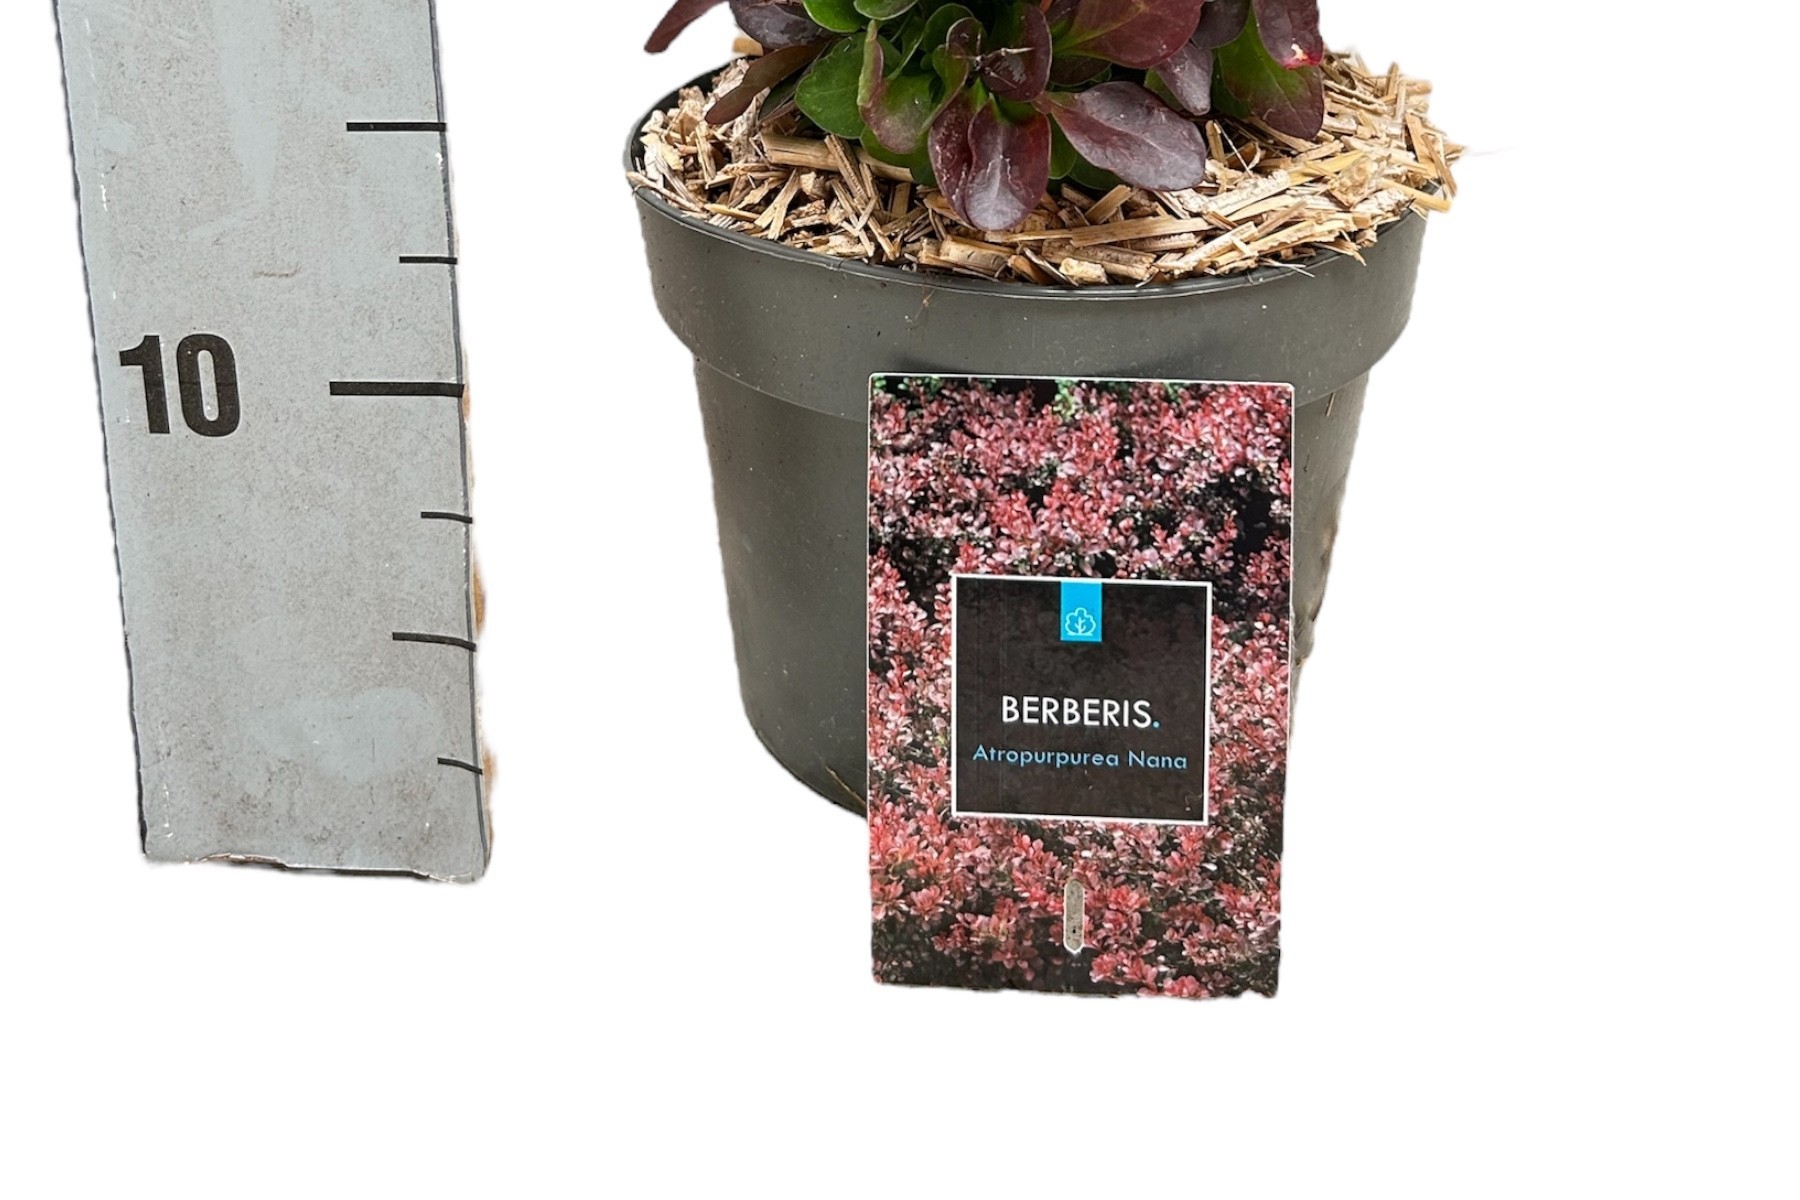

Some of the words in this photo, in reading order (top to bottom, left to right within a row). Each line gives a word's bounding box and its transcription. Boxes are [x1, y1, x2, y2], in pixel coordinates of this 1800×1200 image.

[119, 333, 240, 438] 10
[1001, 695, 1160, 729] BERBERIS.
[972, 744, 1119, 769] Atropurpurea
[1127, 750, 1188, 770] Nana
